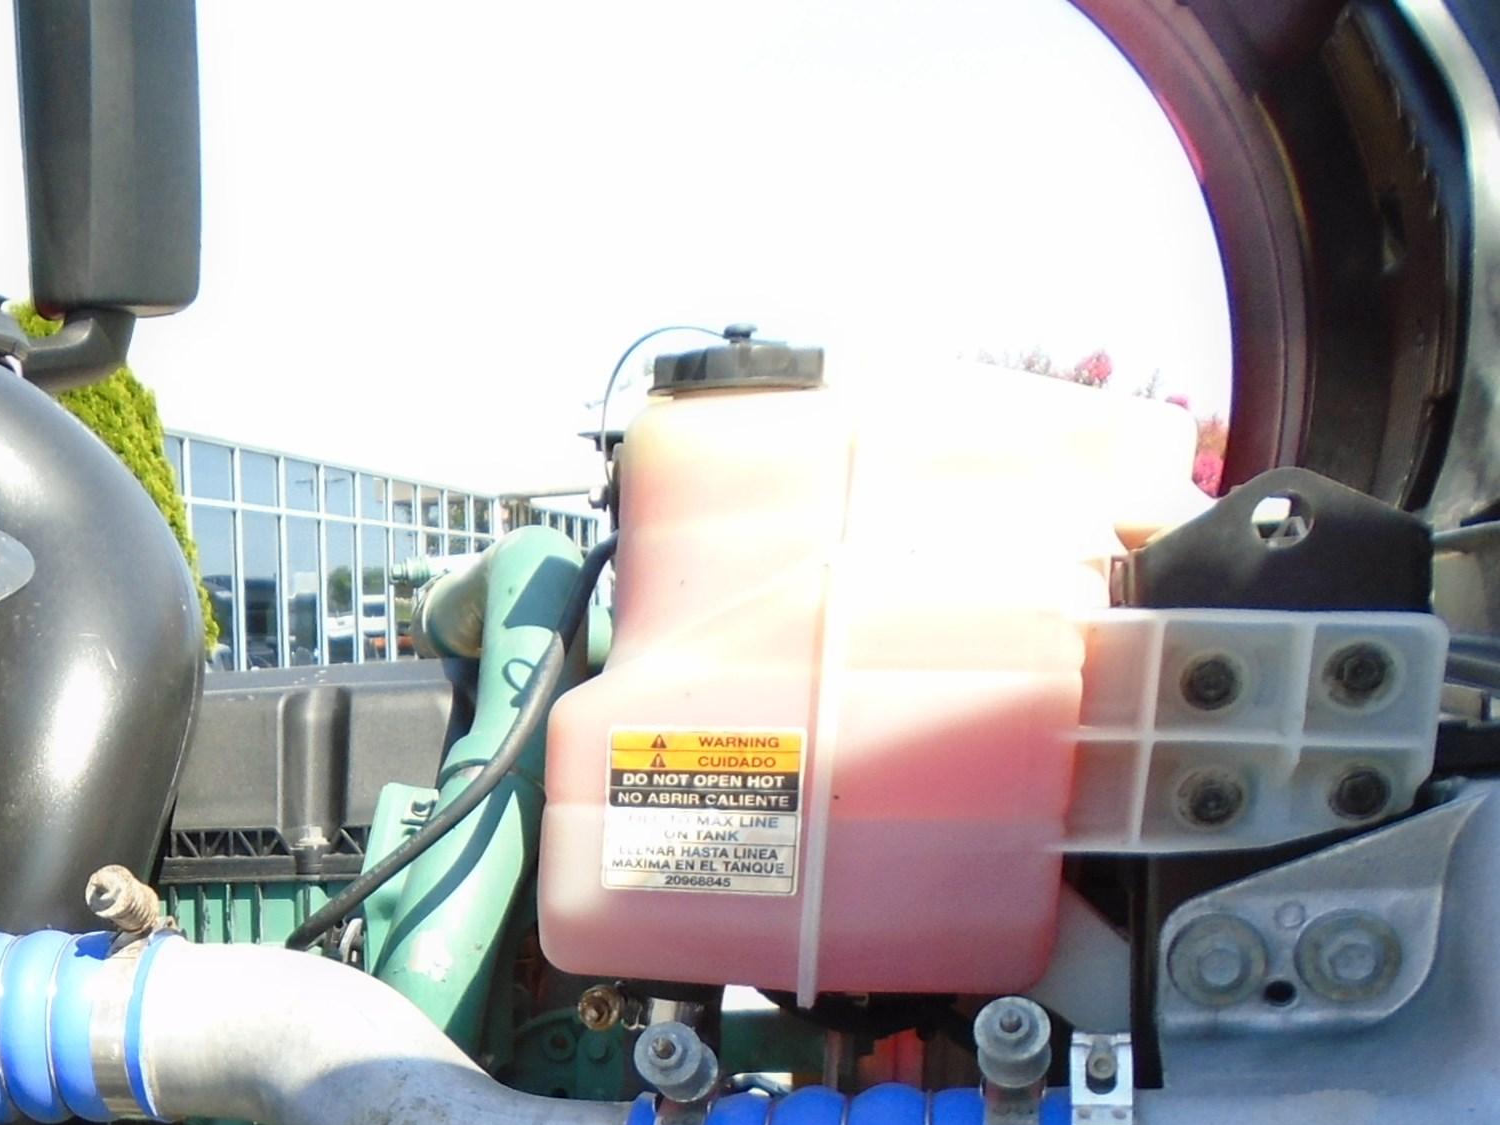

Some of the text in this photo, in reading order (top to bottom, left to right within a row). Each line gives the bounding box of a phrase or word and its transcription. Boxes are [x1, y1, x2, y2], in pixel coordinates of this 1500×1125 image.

[698, 736, 780, 749] WARNING
[697, 755, 777, 769] CUIDADO
[622, 772, 786, 789] DO NOT OPEN HOT
[617, 791, 790, 808] NO ABRIR CALIENTE
[696, 816, 734, 828] MAX
[739, 816, 780, 829] LINE
[695, 830, 740, 842] TANK
[680, 846, 729, 859] HASTA
[733, 847, 780, 861] LINEA
[611, 858, 786, 875] MAXIMA EN EL TANQUE
[664, 874, 732, 888] 20968845
